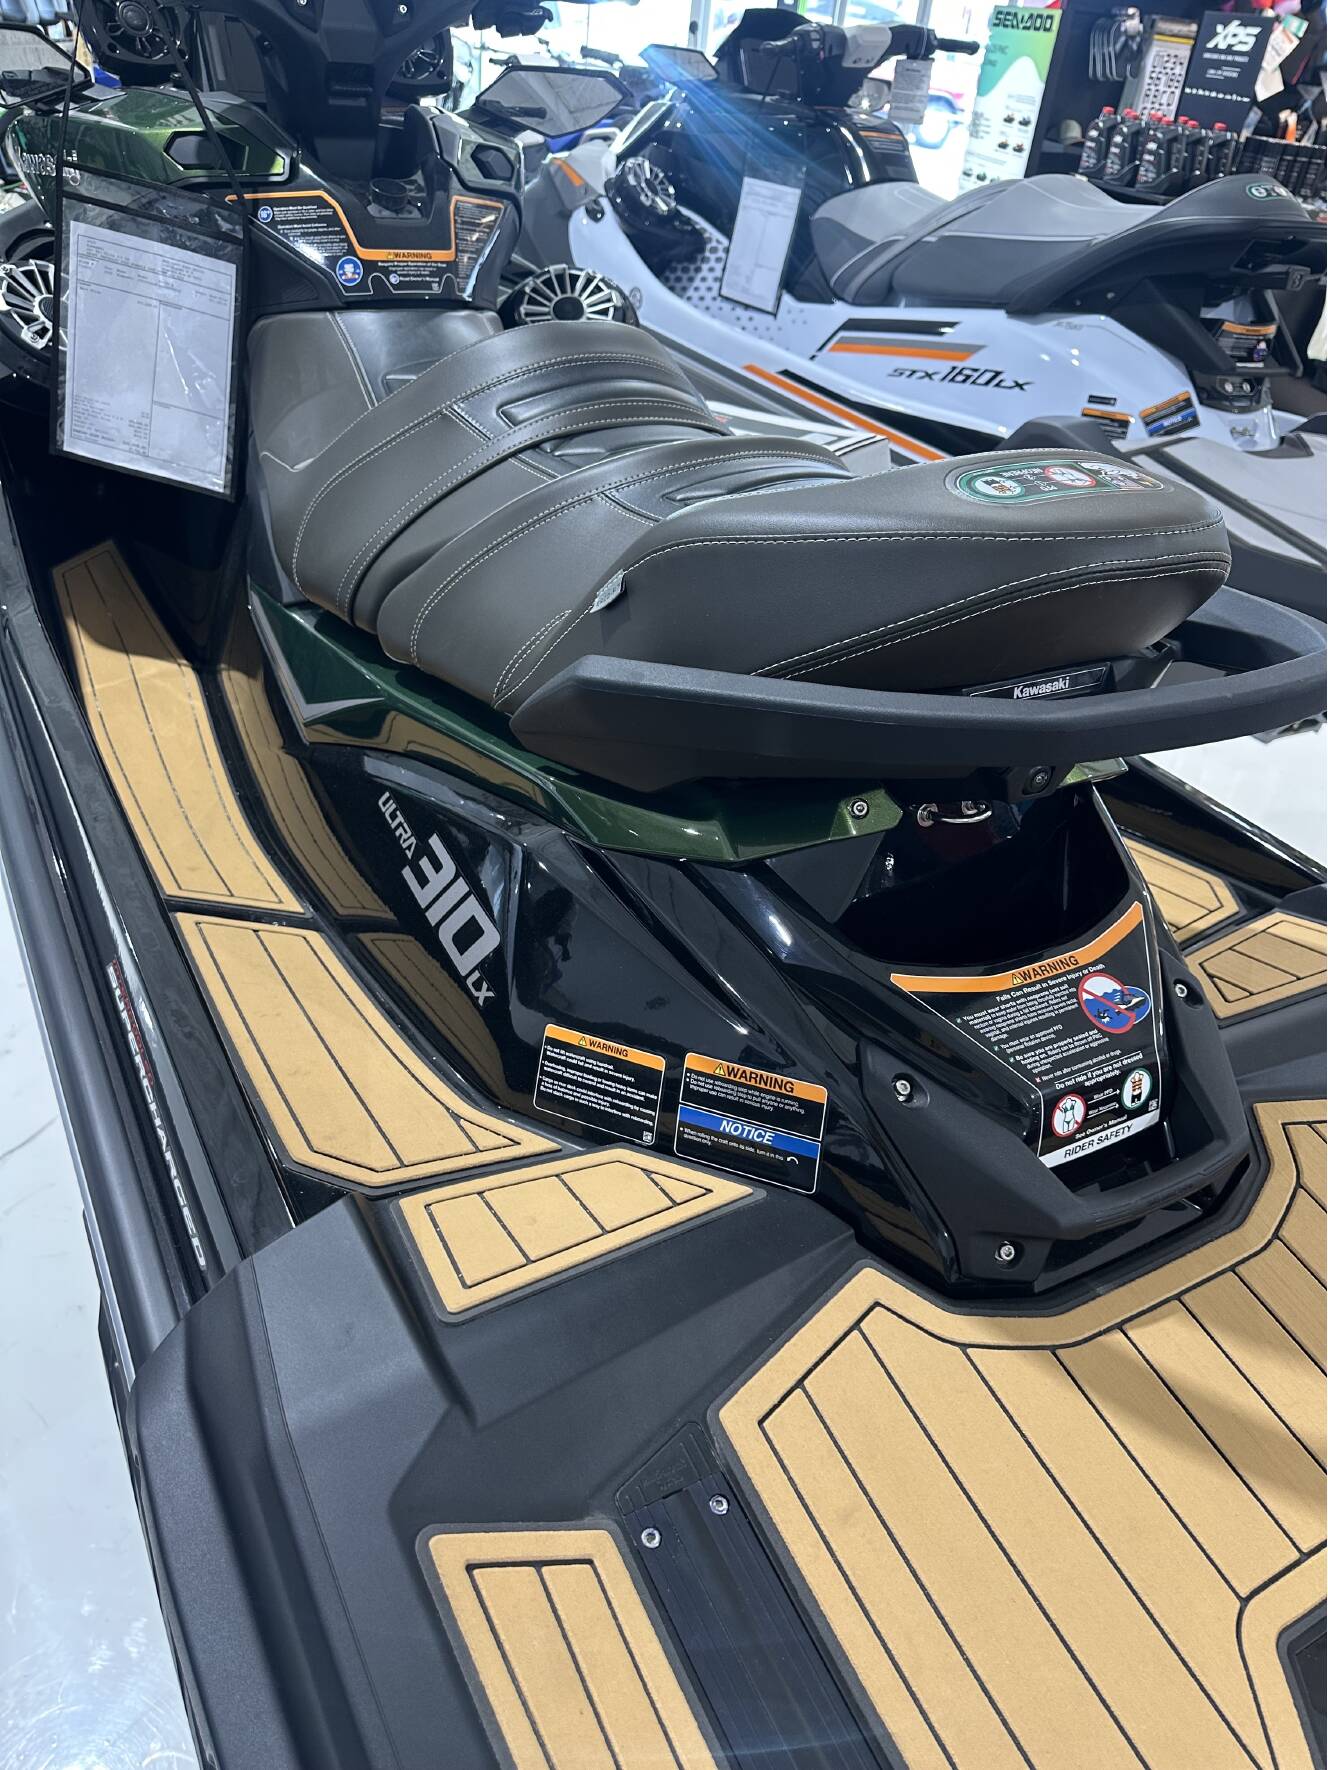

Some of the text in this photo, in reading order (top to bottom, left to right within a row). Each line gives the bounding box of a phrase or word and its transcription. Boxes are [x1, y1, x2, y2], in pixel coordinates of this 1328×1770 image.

[1013, 677, 1070, 699] Kawasaki
[378, 791, 417, 860] ULTRA
[1021, 955, 1080, 982] WARNING
[1023, 984, 1042, 993] Result
[1048, 976, 1067, 985] Severe
[1088, 964, 1105, 972] Death
[589, 1039, 628, 1057] WARNING
[727, 1066, 794, 1093] WARNING
[1065, 1079, 1076, 1087] not
[1092, 1070, 1103, 1080] you
[1113, 1060, 1122, 1070] not
[1122, 1053, 1144, 1066] dressed
[106, 962, 207, 1271] SUPERCHARGED
[720, 1120, 774, 1144] NOTICE
[1064, 1123, 1134, 1158] RIDER SAFETY
